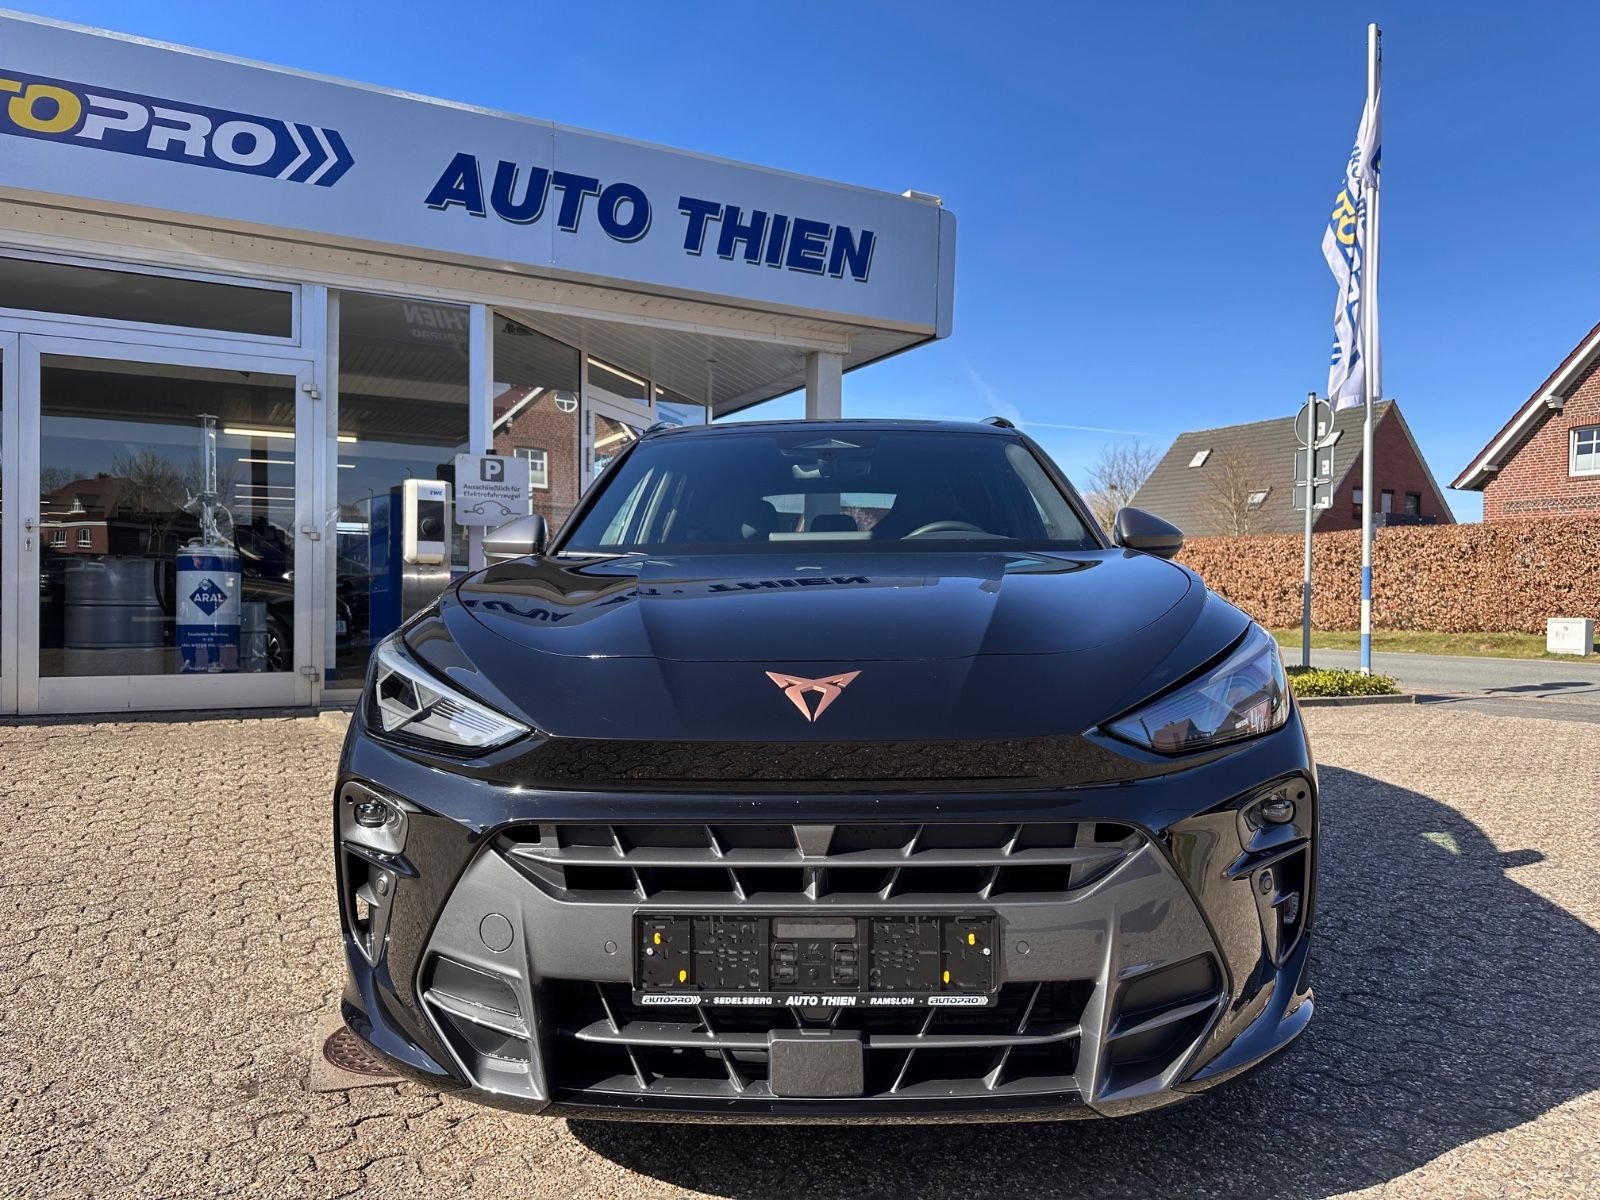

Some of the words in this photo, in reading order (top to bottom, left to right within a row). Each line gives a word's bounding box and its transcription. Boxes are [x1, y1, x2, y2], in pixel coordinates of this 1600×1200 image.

[424, 152, 652, 244] AUTO
[677, 195, 877, 282] THIEN
[485, 460, 501, 480] P
[463, 483, 510, 492] Ausschließlich
[193, 593, 224, 602] ARAL
[713, 996, 772, 1005] SEDELSBERG
[786, 995, 818, 1006] AUTO
[821, 996, 857, 1006] THIEN
[870, 997, 914, 1005] RAMSLOH
